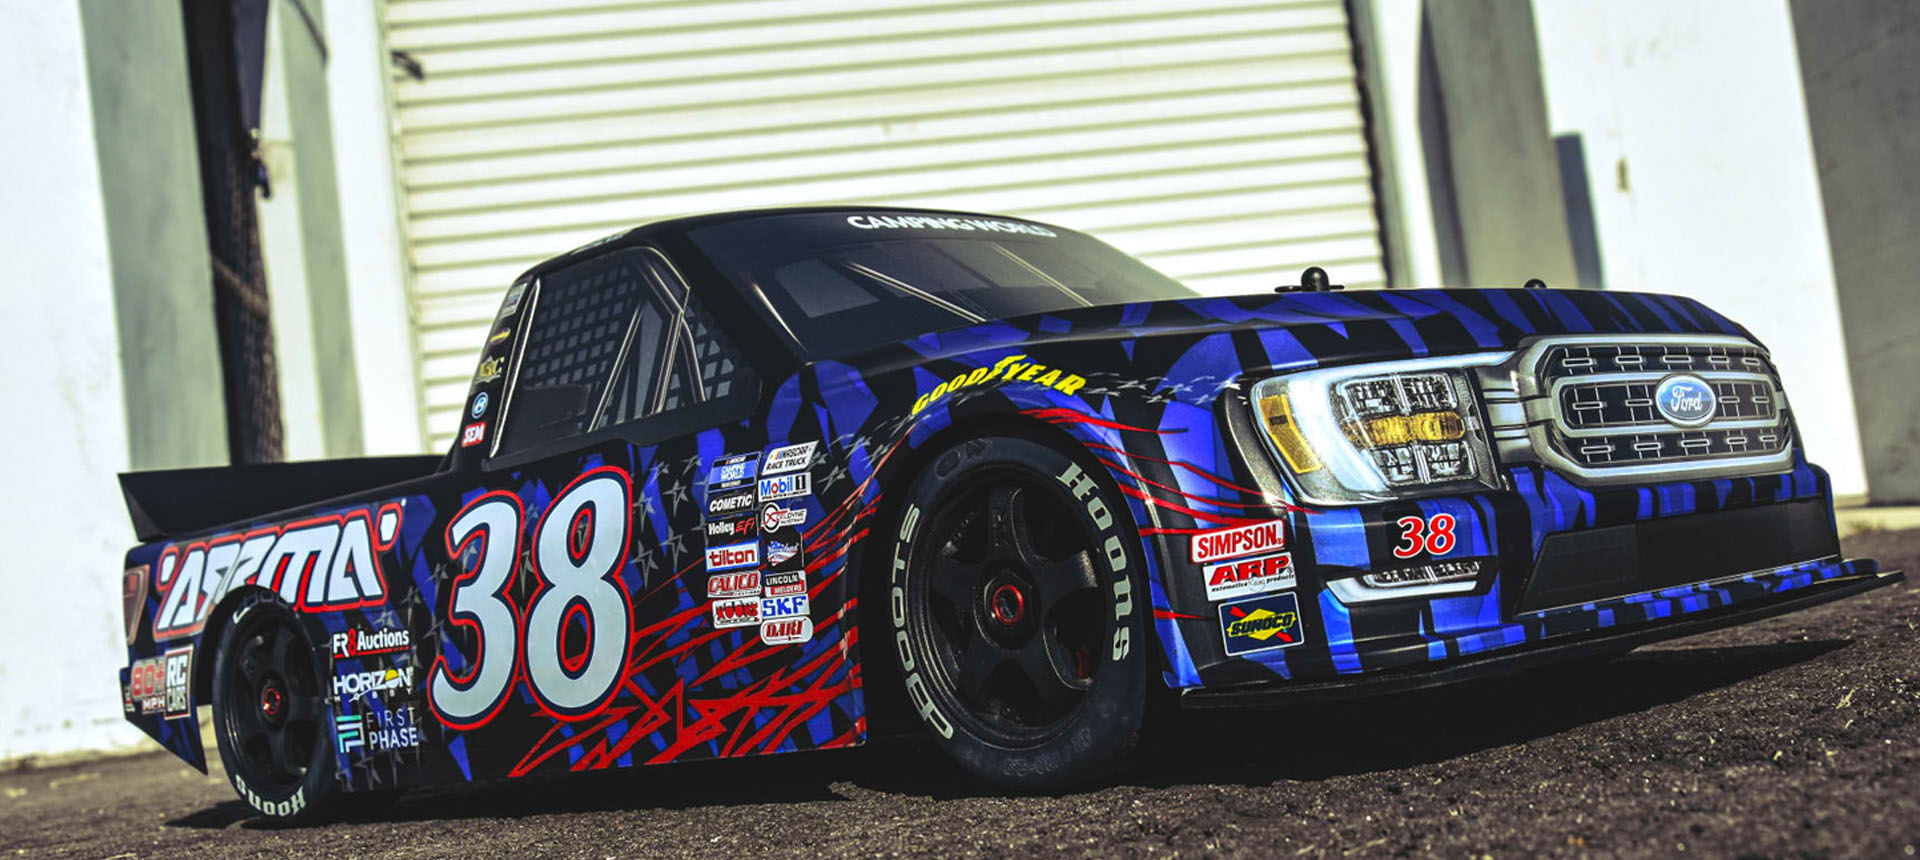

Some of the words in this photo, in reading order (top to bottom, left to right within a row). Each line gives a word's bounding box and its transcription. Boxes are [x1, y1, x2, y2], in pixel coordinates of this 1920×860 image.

[846, 215, 972, 231] CAMPING
[911, 354, 1086, 416] GOODYEAR
[1671, 384, 1704, 412] Ford
[463, 424, 485, 444] SEM
[766, 460, 784, 471] RACE
[785, 456, 807, 468] TRUCK
[760, 476, 793, 496] Mobil
[796, 475, 806, 490] 1
[709, 494, 753, 513] COMETIC
[708, 521, 735, 536] Holley
[735, 517, 755, 536] EFI
[1394, 512, 1457, 559] 38
[1197, 524, 1278, 559] SIMPSON
[709, 549, 755, 567] tilton
[1056, 461, 1133, 662] Hoons
[765, 573, 799, 586] LINCOLN
[1209, 555, 1291, 587] ARP
[708, 573, 758, 593] CALICO
[429, 467, 633, 728] 38
[762, 596, 807, 617] SKF
[1231, 613, 1291, 634] SUNOCO
[167, 655, 188, 687] RC
[366, 707, 415, 729] FIRST
[369, 727, 419, 750] PHASE
[235, 773, 307, 817] Hoons
